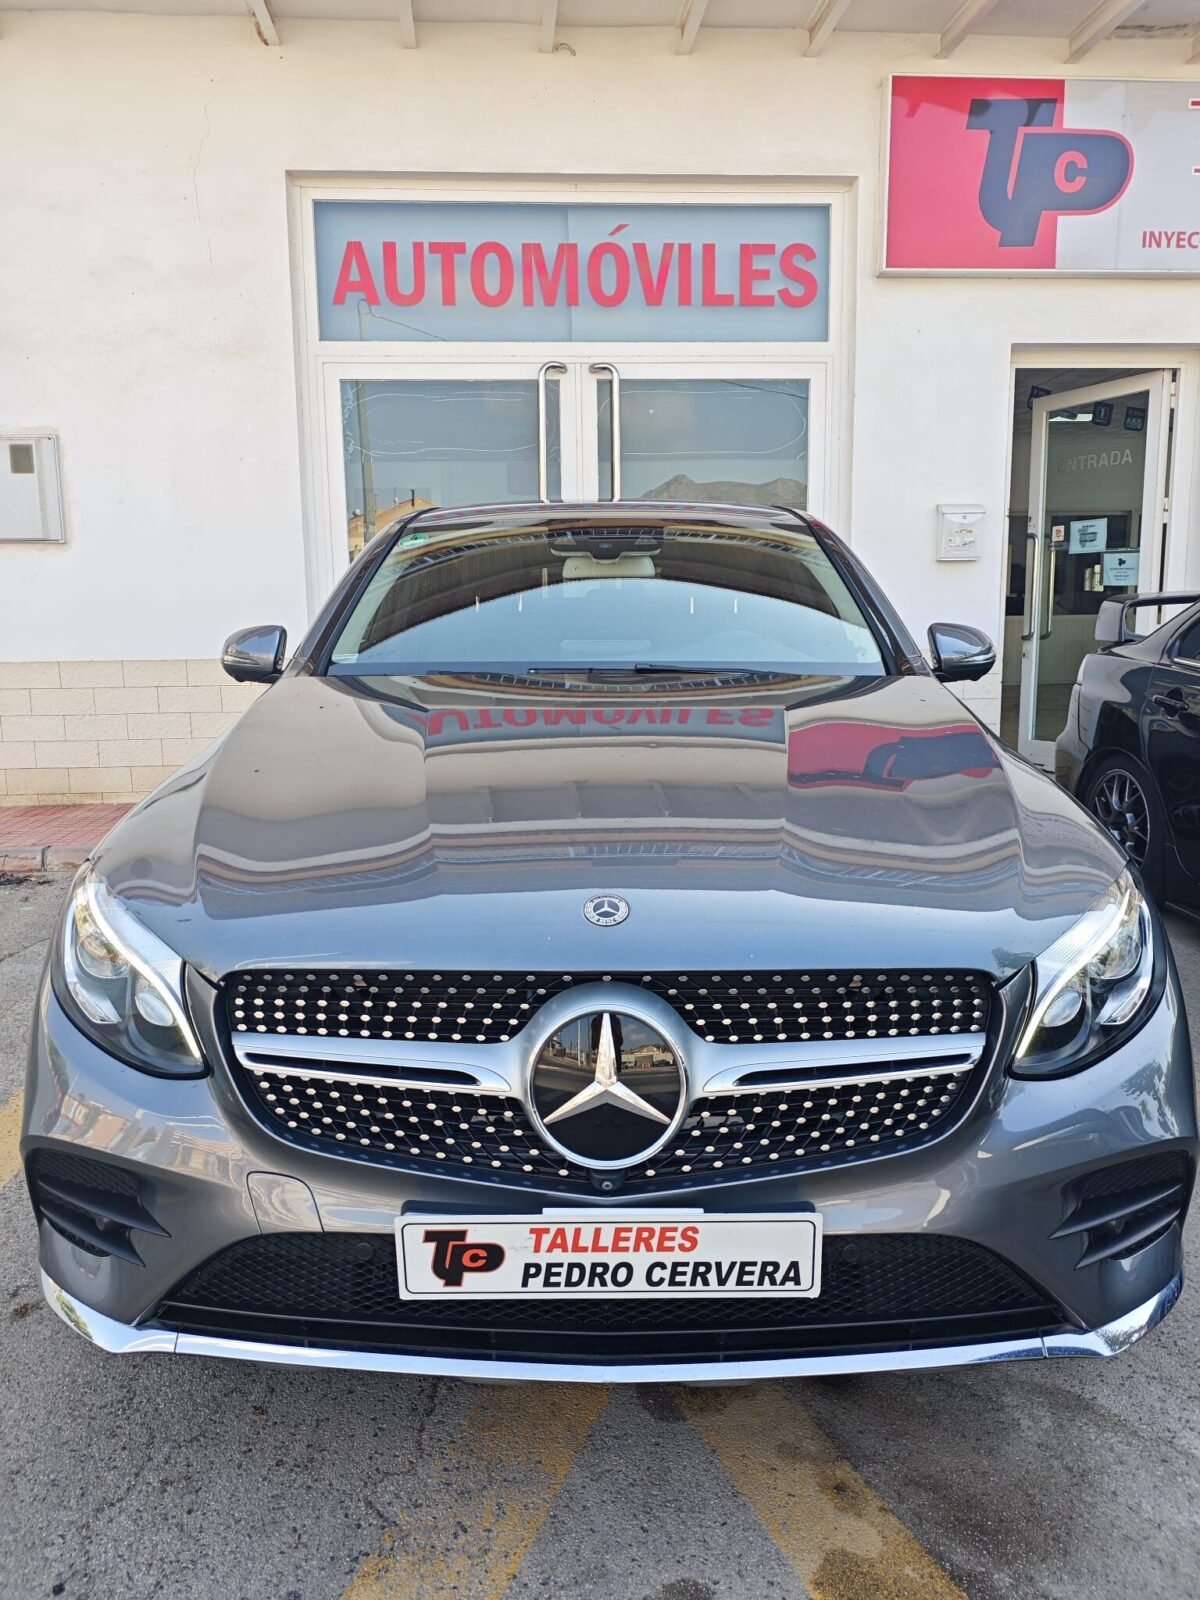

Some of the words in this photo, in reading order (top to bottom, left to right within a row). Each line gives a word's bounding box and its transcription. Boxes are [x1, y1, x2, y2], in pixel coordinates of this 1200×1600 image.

[1141, 230, 1200, 250] INYEC
[333, 224, 818, 308] AUTOMÓVILES
[529, 1225, 700, 1253] TALLERES
[521, 1261, 634, 1288] PEDRO
[645, 1260, 802, 1287] CERVERA
